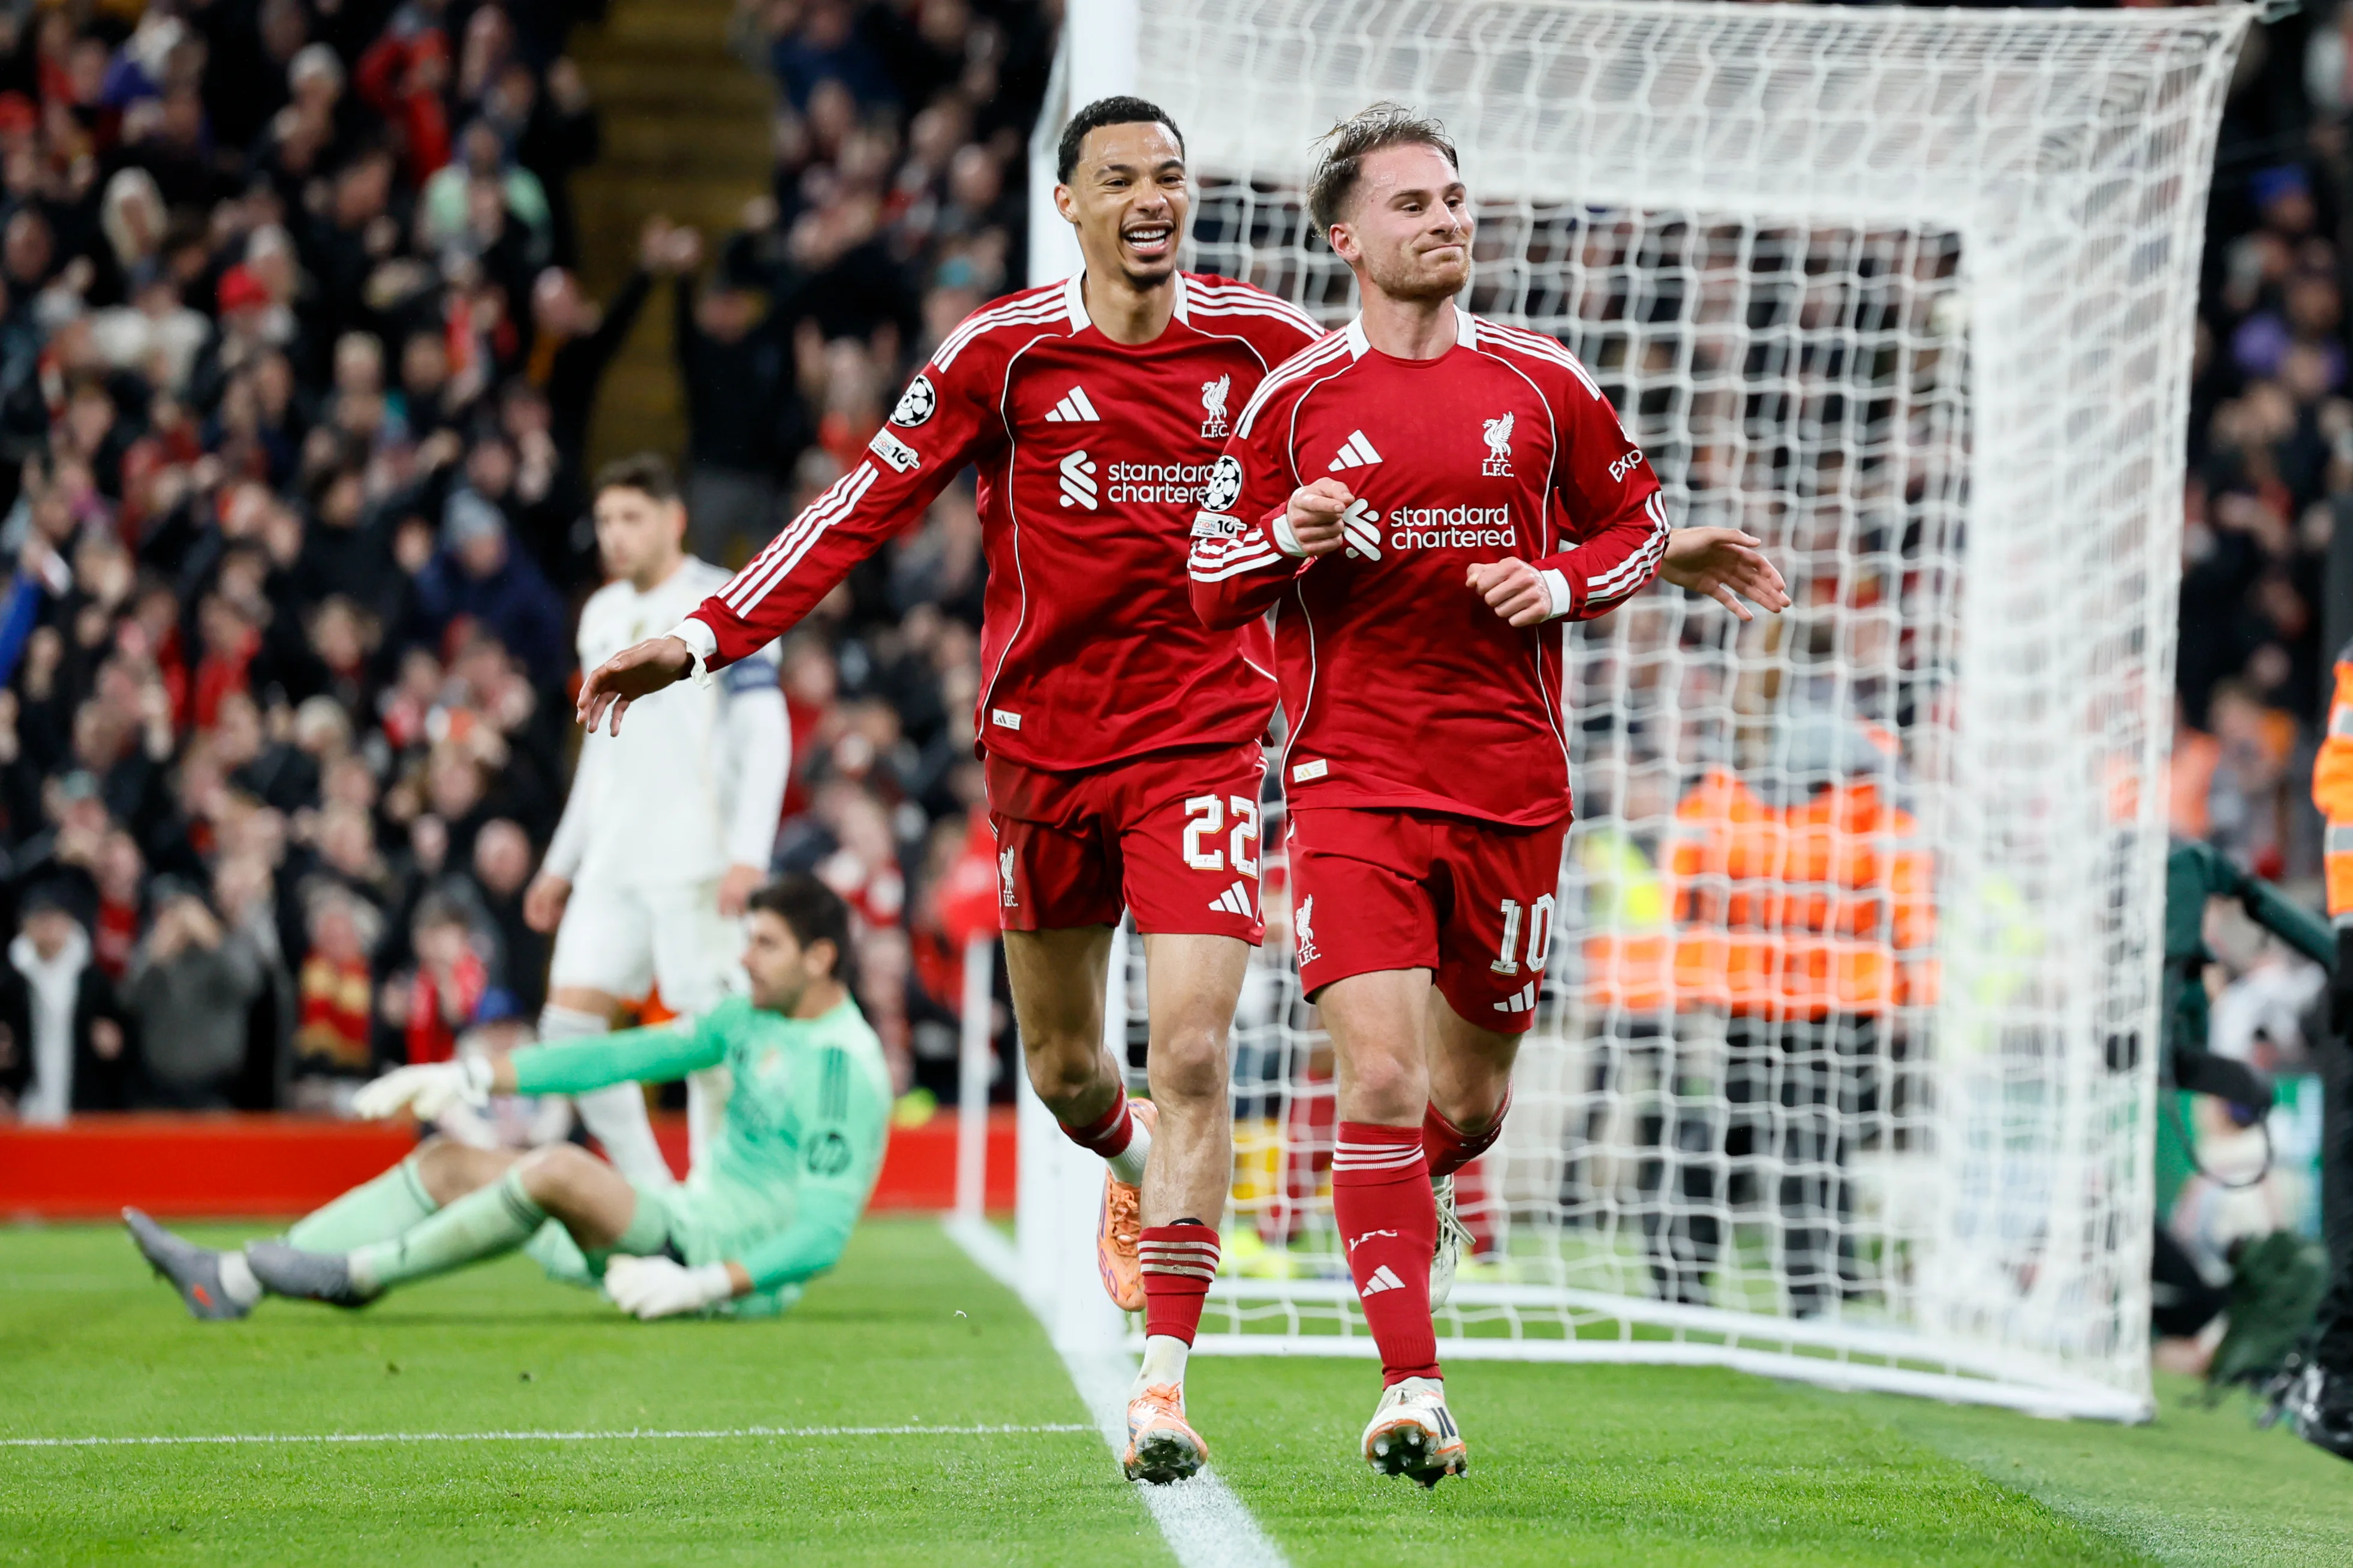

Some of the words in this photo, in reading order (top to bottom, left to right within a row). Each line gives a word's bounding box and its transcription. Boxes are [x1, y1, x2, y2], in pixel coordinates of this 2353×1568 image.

[1201, 424, 1230, 438] L.F.C.
[1482, 462, 1515, 477] L.F.C.
[1608, 449, 1643, 483] Exp
[1108, 482, 1206, 503] chartere
[1390, 503, 1509, 527] standard
[1391, 525, 1516, 550] chartered
[1183, 793, 1259, 880] 22
[1490, 892, 1555, 977] 10
